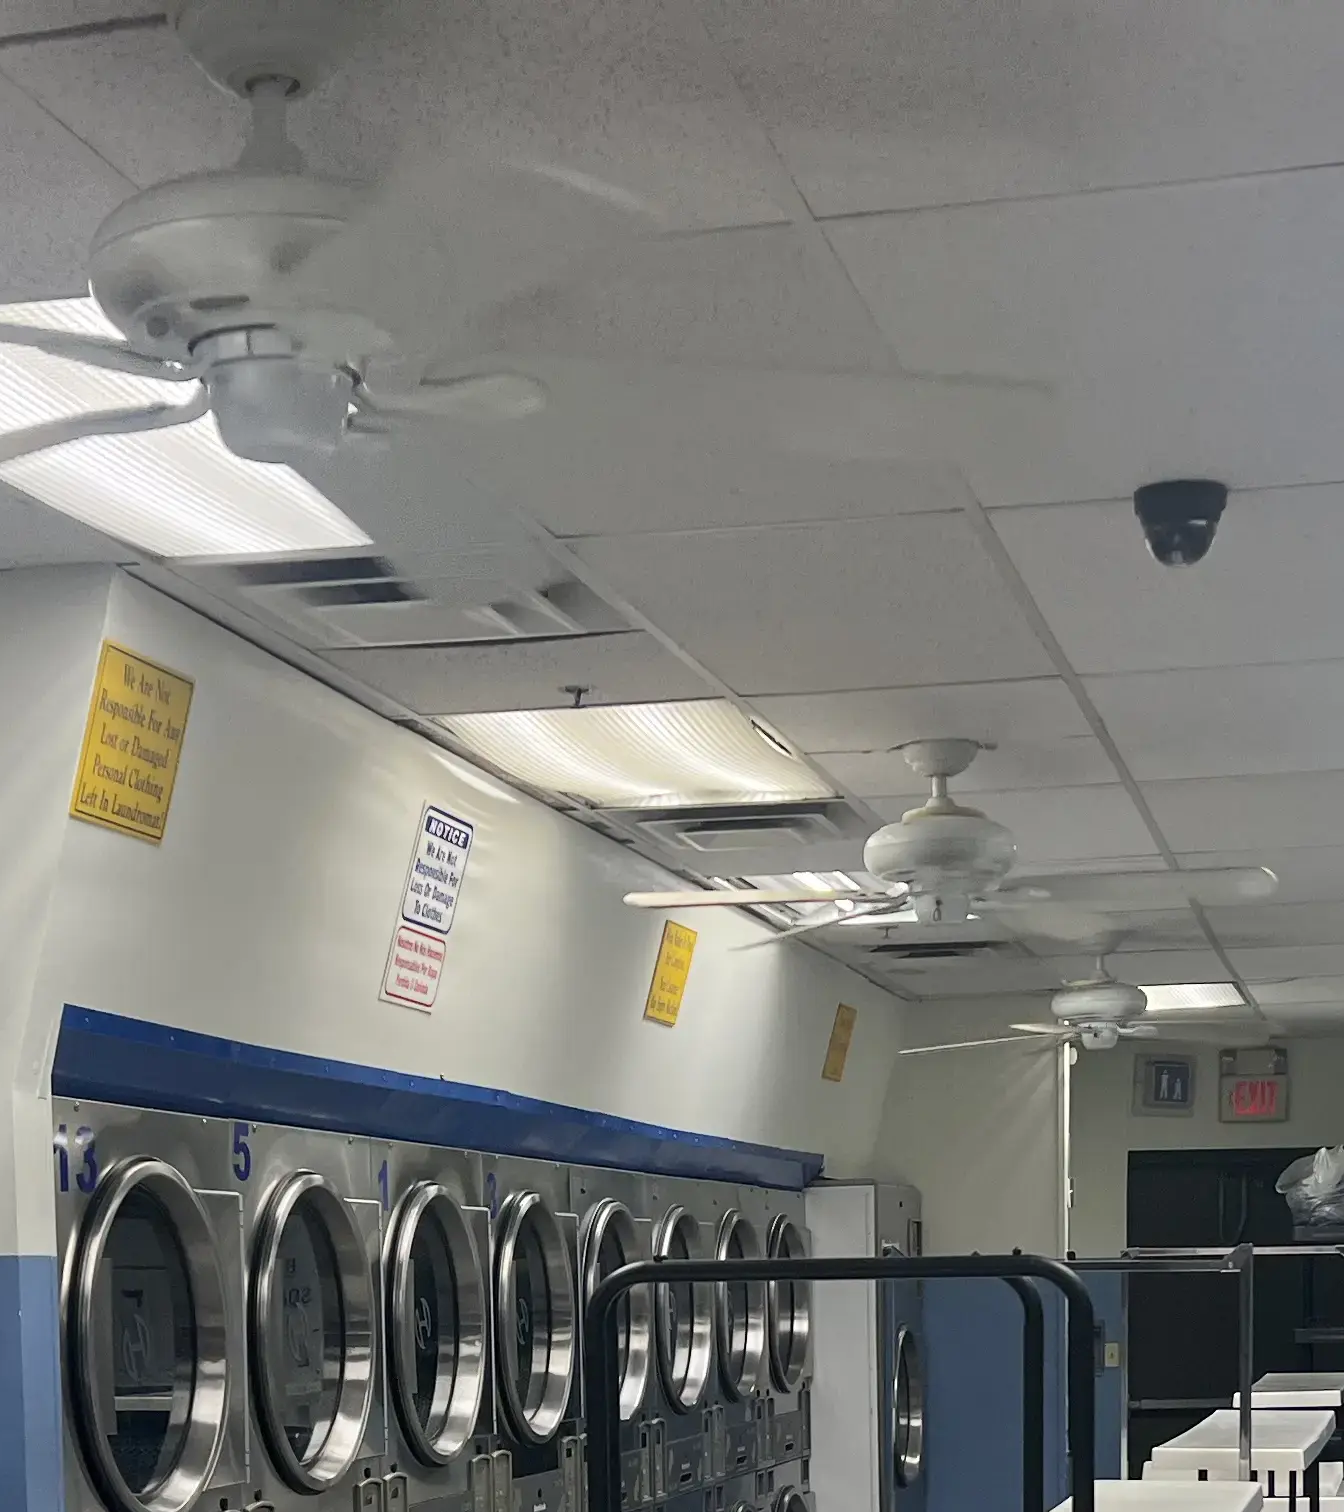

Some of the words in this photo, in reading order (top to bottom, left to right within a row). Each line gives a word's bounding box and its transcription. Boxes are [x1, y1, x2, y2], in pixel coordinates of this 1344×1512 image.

[123, 664, 136, 690] We
[138, 673, 154, 696] Are
[157, 679, 171, 705] Not
[99, 688, 146, 728] Responsible
[148, 709, 162, 734] For
[166, 716, 181, 742] Any
[100, 722, 119, 751] Lost
[119, 736, 130, 753] or
[131, 735, 170, 770] Damaged
[79, 782, 97, 807] Left
[99, 788, 109, 812] In
[93, 753, 127, 786] Personal
[128, 768, 164, 803] Clothing
[426, 840, 435, 859] We
[436, 845, 446, 861] Are
[447, 850, 457, 867] Not
[428, 818, 467, 847] NOTICE
[1233, 1081, 1278, 1115] EXIT
[53, 1124, 97, 1193] 13
[232, 1122, 251, 1181] 5
